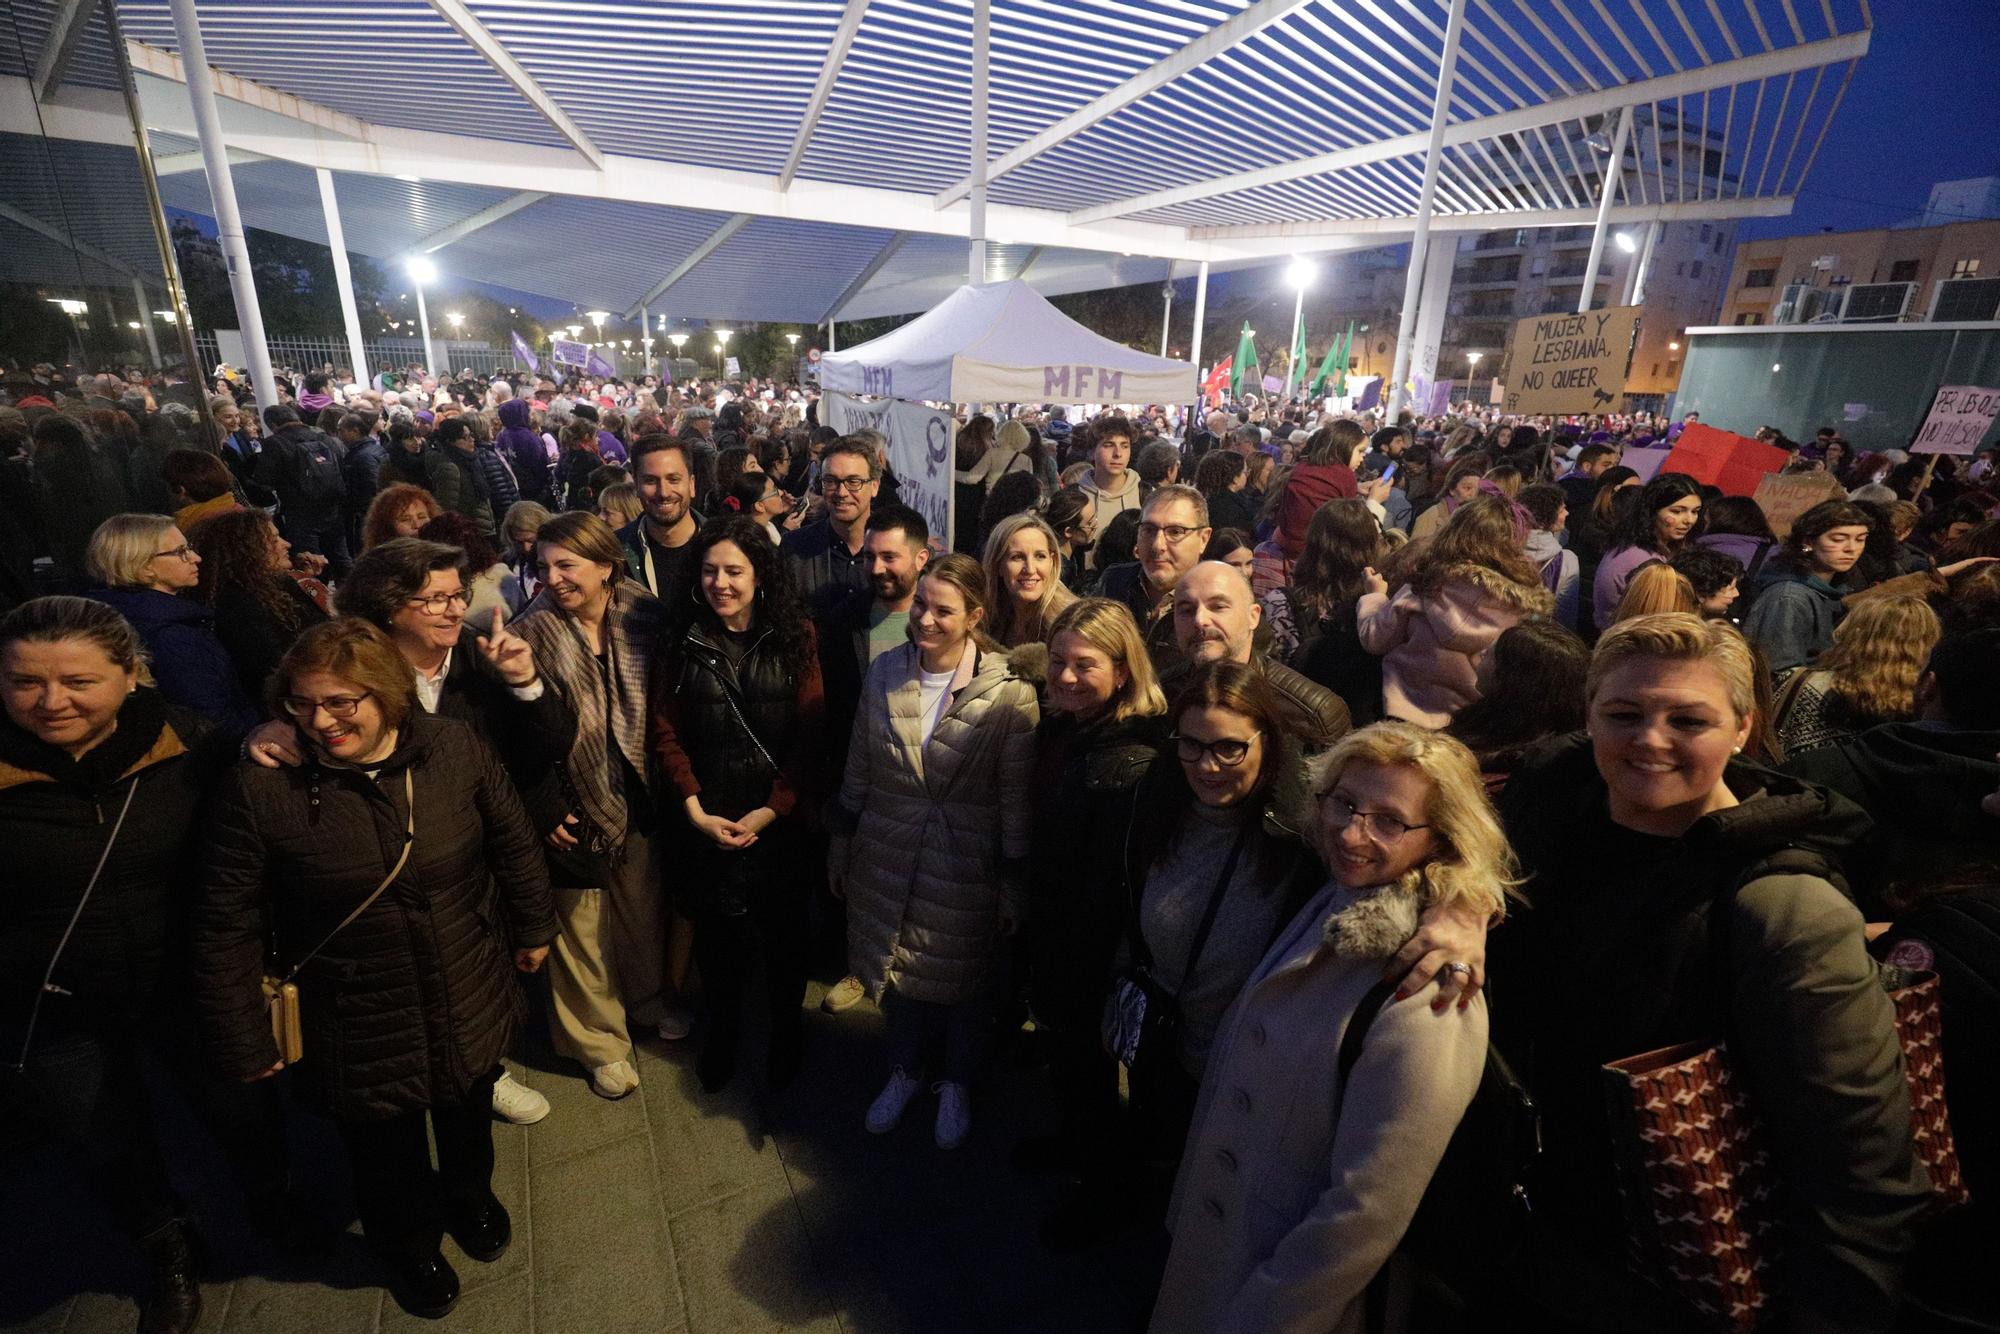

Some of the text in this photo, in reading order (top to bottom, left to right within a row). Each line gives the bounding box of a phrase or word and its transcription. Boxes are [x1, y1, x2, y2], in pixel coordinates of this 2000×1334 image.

[1534, 314, 1611, 341] MUJER Y
[1531, 336, 1612, 364] LESBIANA,
[862, 365, 893, 396] MFM
[1044, 365, 1123, 400] MFM
[1521, 366, 1599, 390] NO QUEER
